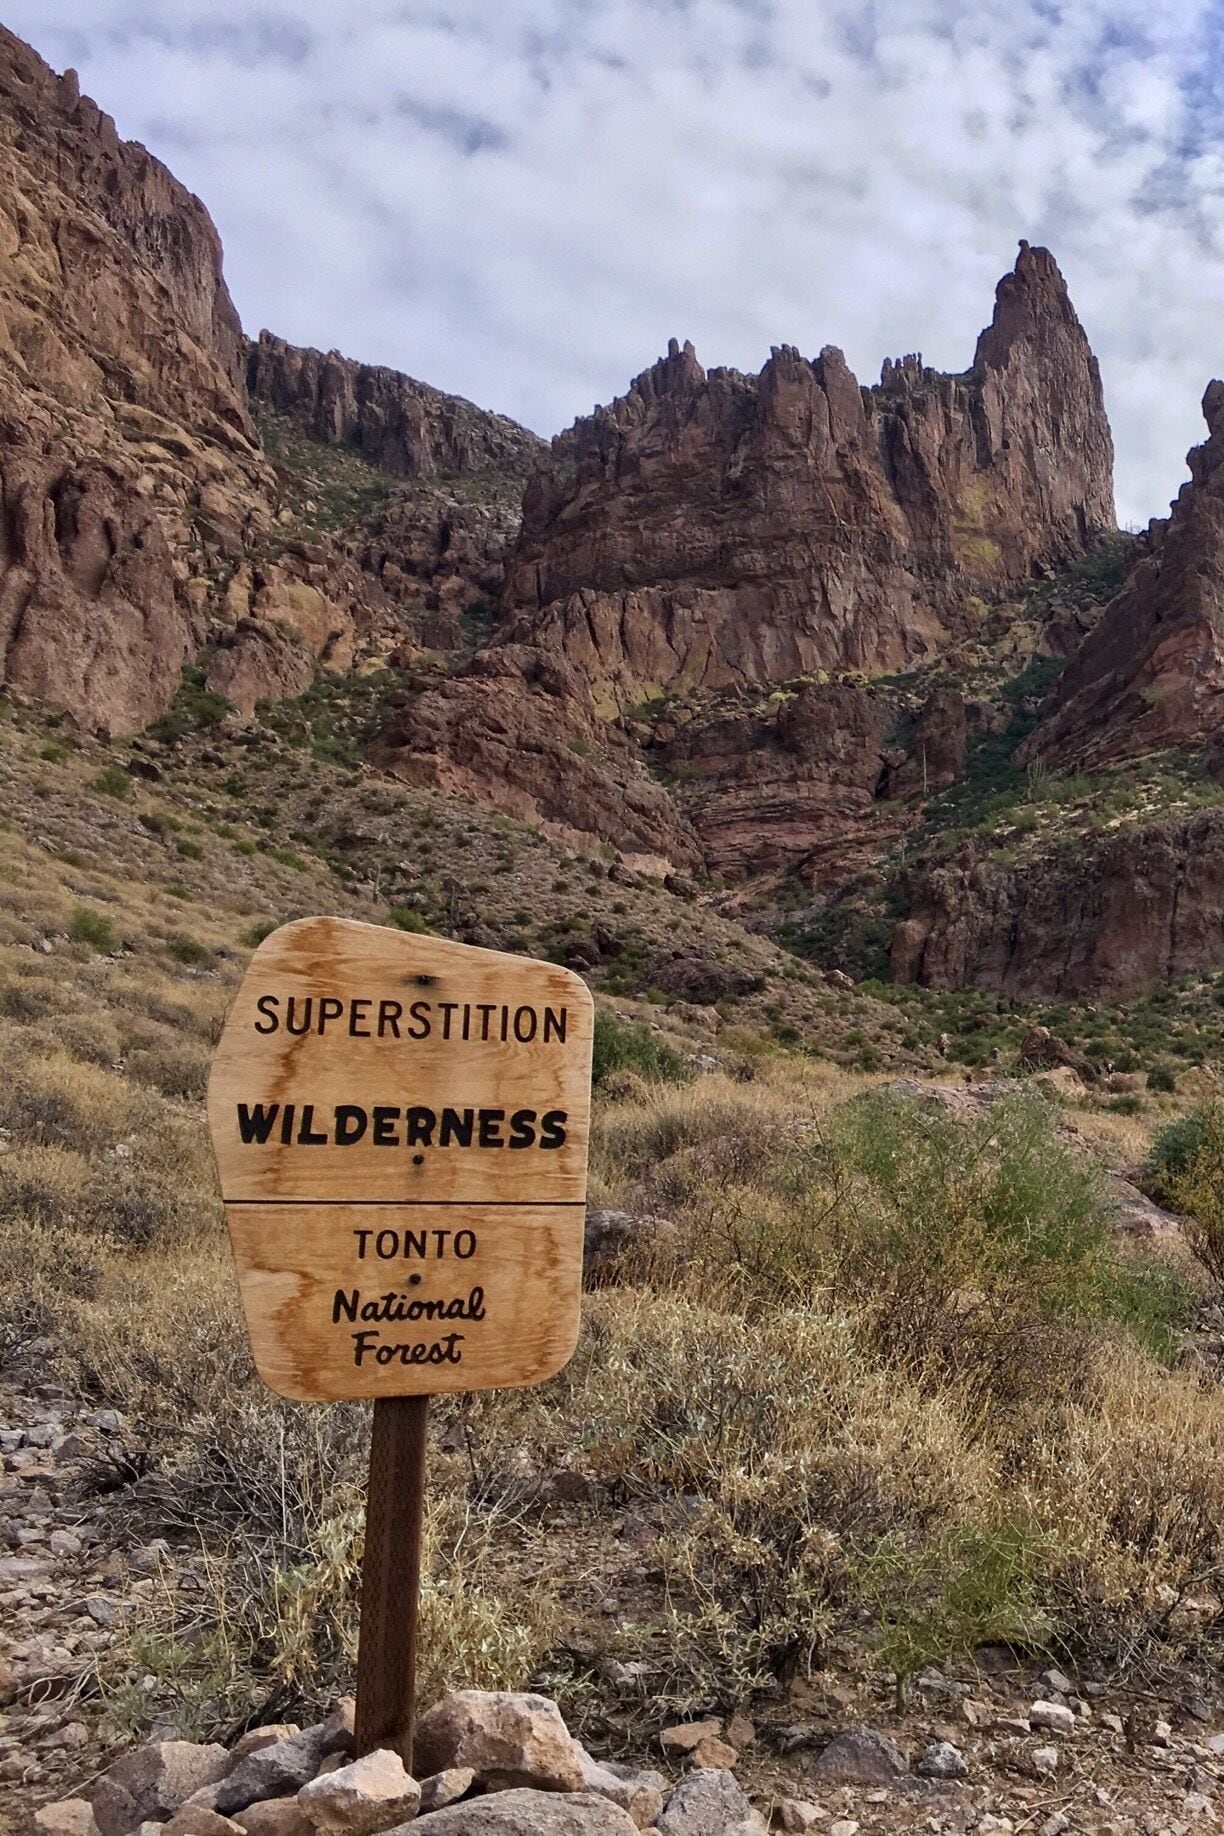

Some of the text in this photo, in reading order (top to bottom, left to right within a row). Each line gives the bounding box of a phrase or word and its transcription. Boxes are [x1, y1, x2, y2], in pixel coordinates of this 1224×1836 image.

[254, 995, 568, 1044] SUPERSTITION
[237, 1103, 569, 1150] WILDERNESS
[353, 1230, 477, 1259] TONTO
[332, 1286, 486, 1324] National
[351, 1330, 465, 1367] Forest
